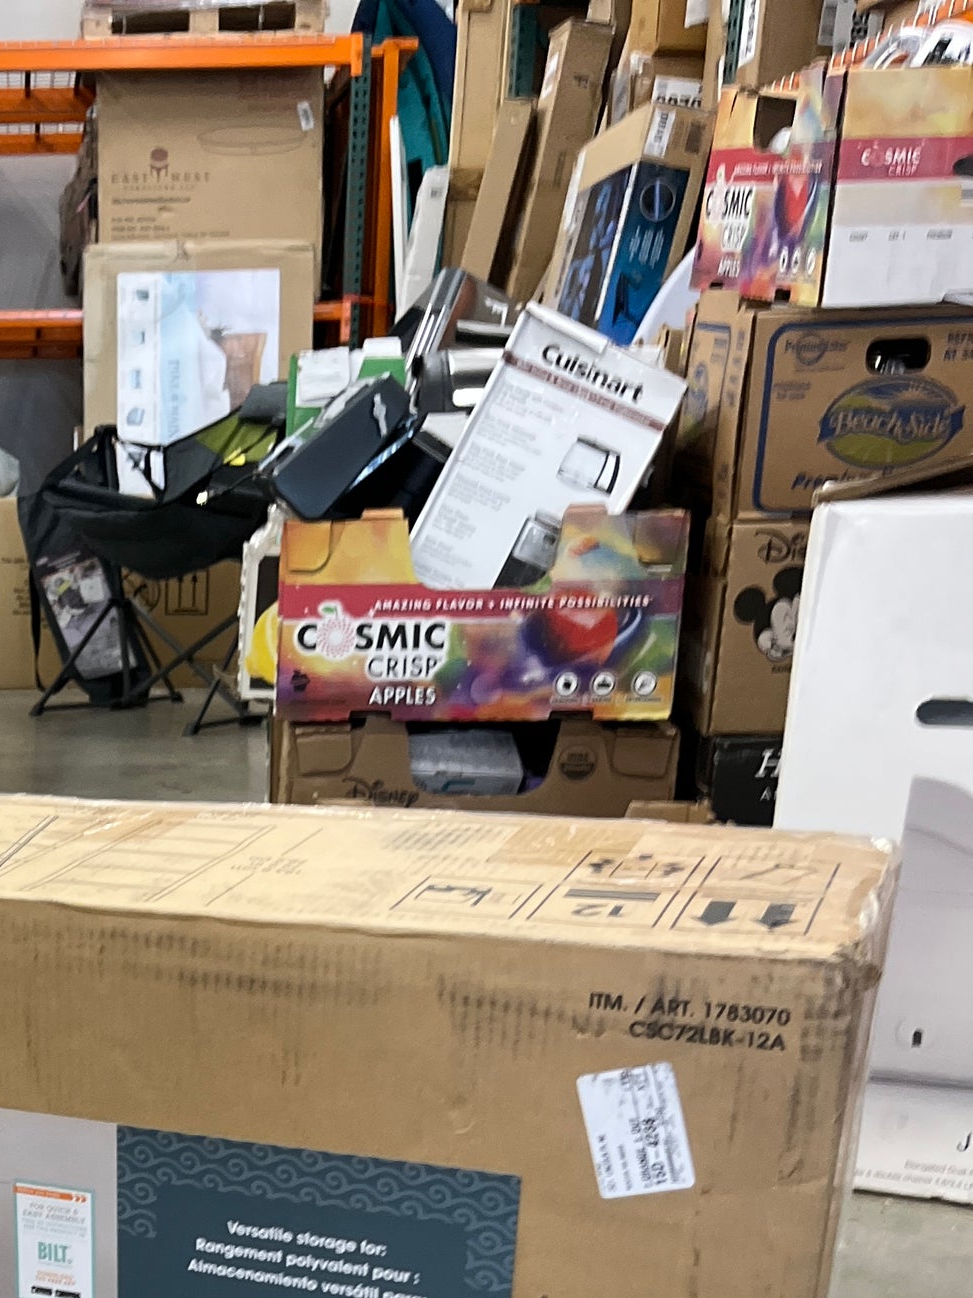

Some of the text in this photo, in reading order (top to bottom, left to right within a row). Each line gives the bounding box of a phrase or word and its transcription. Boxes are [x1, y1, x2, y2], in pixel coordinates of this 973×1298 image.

[542, 343, 644, 405] Cuisinart
[375, 599, 431, 612] AMAZING
[436, 599, 483, 611] FLAVOR
[499, 597, 554, 610] INFINITE
[559, 594, 653, 608] POSSIBILITIES
[367, 656, 440, 679] CRISP
[369, 687, 436, 706] APPLES
[589, 991, 629, 1012] ITM.
[650, 998, 695, 1018] ART.
[704, 1001, 791, 1027] 1783070
[628, 1020, 786, 1052] CSC72LBK-12A
[37, 1241, 69, 1263] BILT
[227, 1219, 387, 1257] Versatile storage for:
[187, 1257, 318, 1291] Almacenamiento
[195, 1237, 283, 1263] Rangement
[285, 1252, 370, 1278] polyvalent
[372, 1266, 411, 1284] pour
